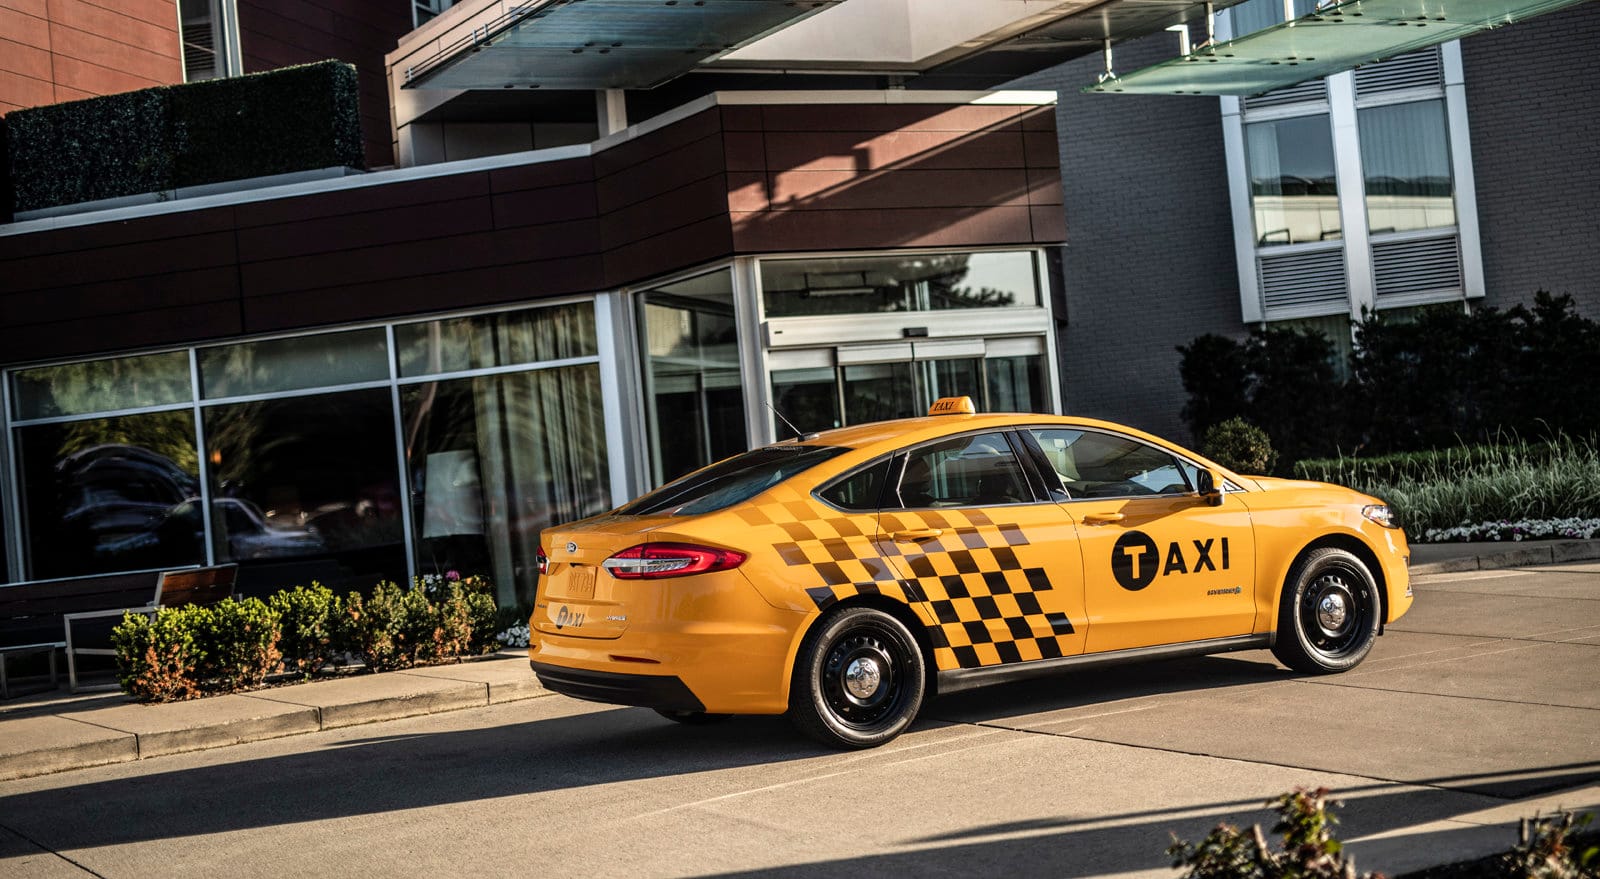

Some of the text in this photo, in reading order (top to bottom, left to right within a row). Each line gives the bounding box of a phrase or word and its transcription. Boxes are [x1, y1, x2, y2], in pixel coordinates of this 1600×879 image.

[934, 401, 955, 411] TAXI
[1123, 537, 1230, 579] TAXI
[559, 611, 585, 627] TAXI
